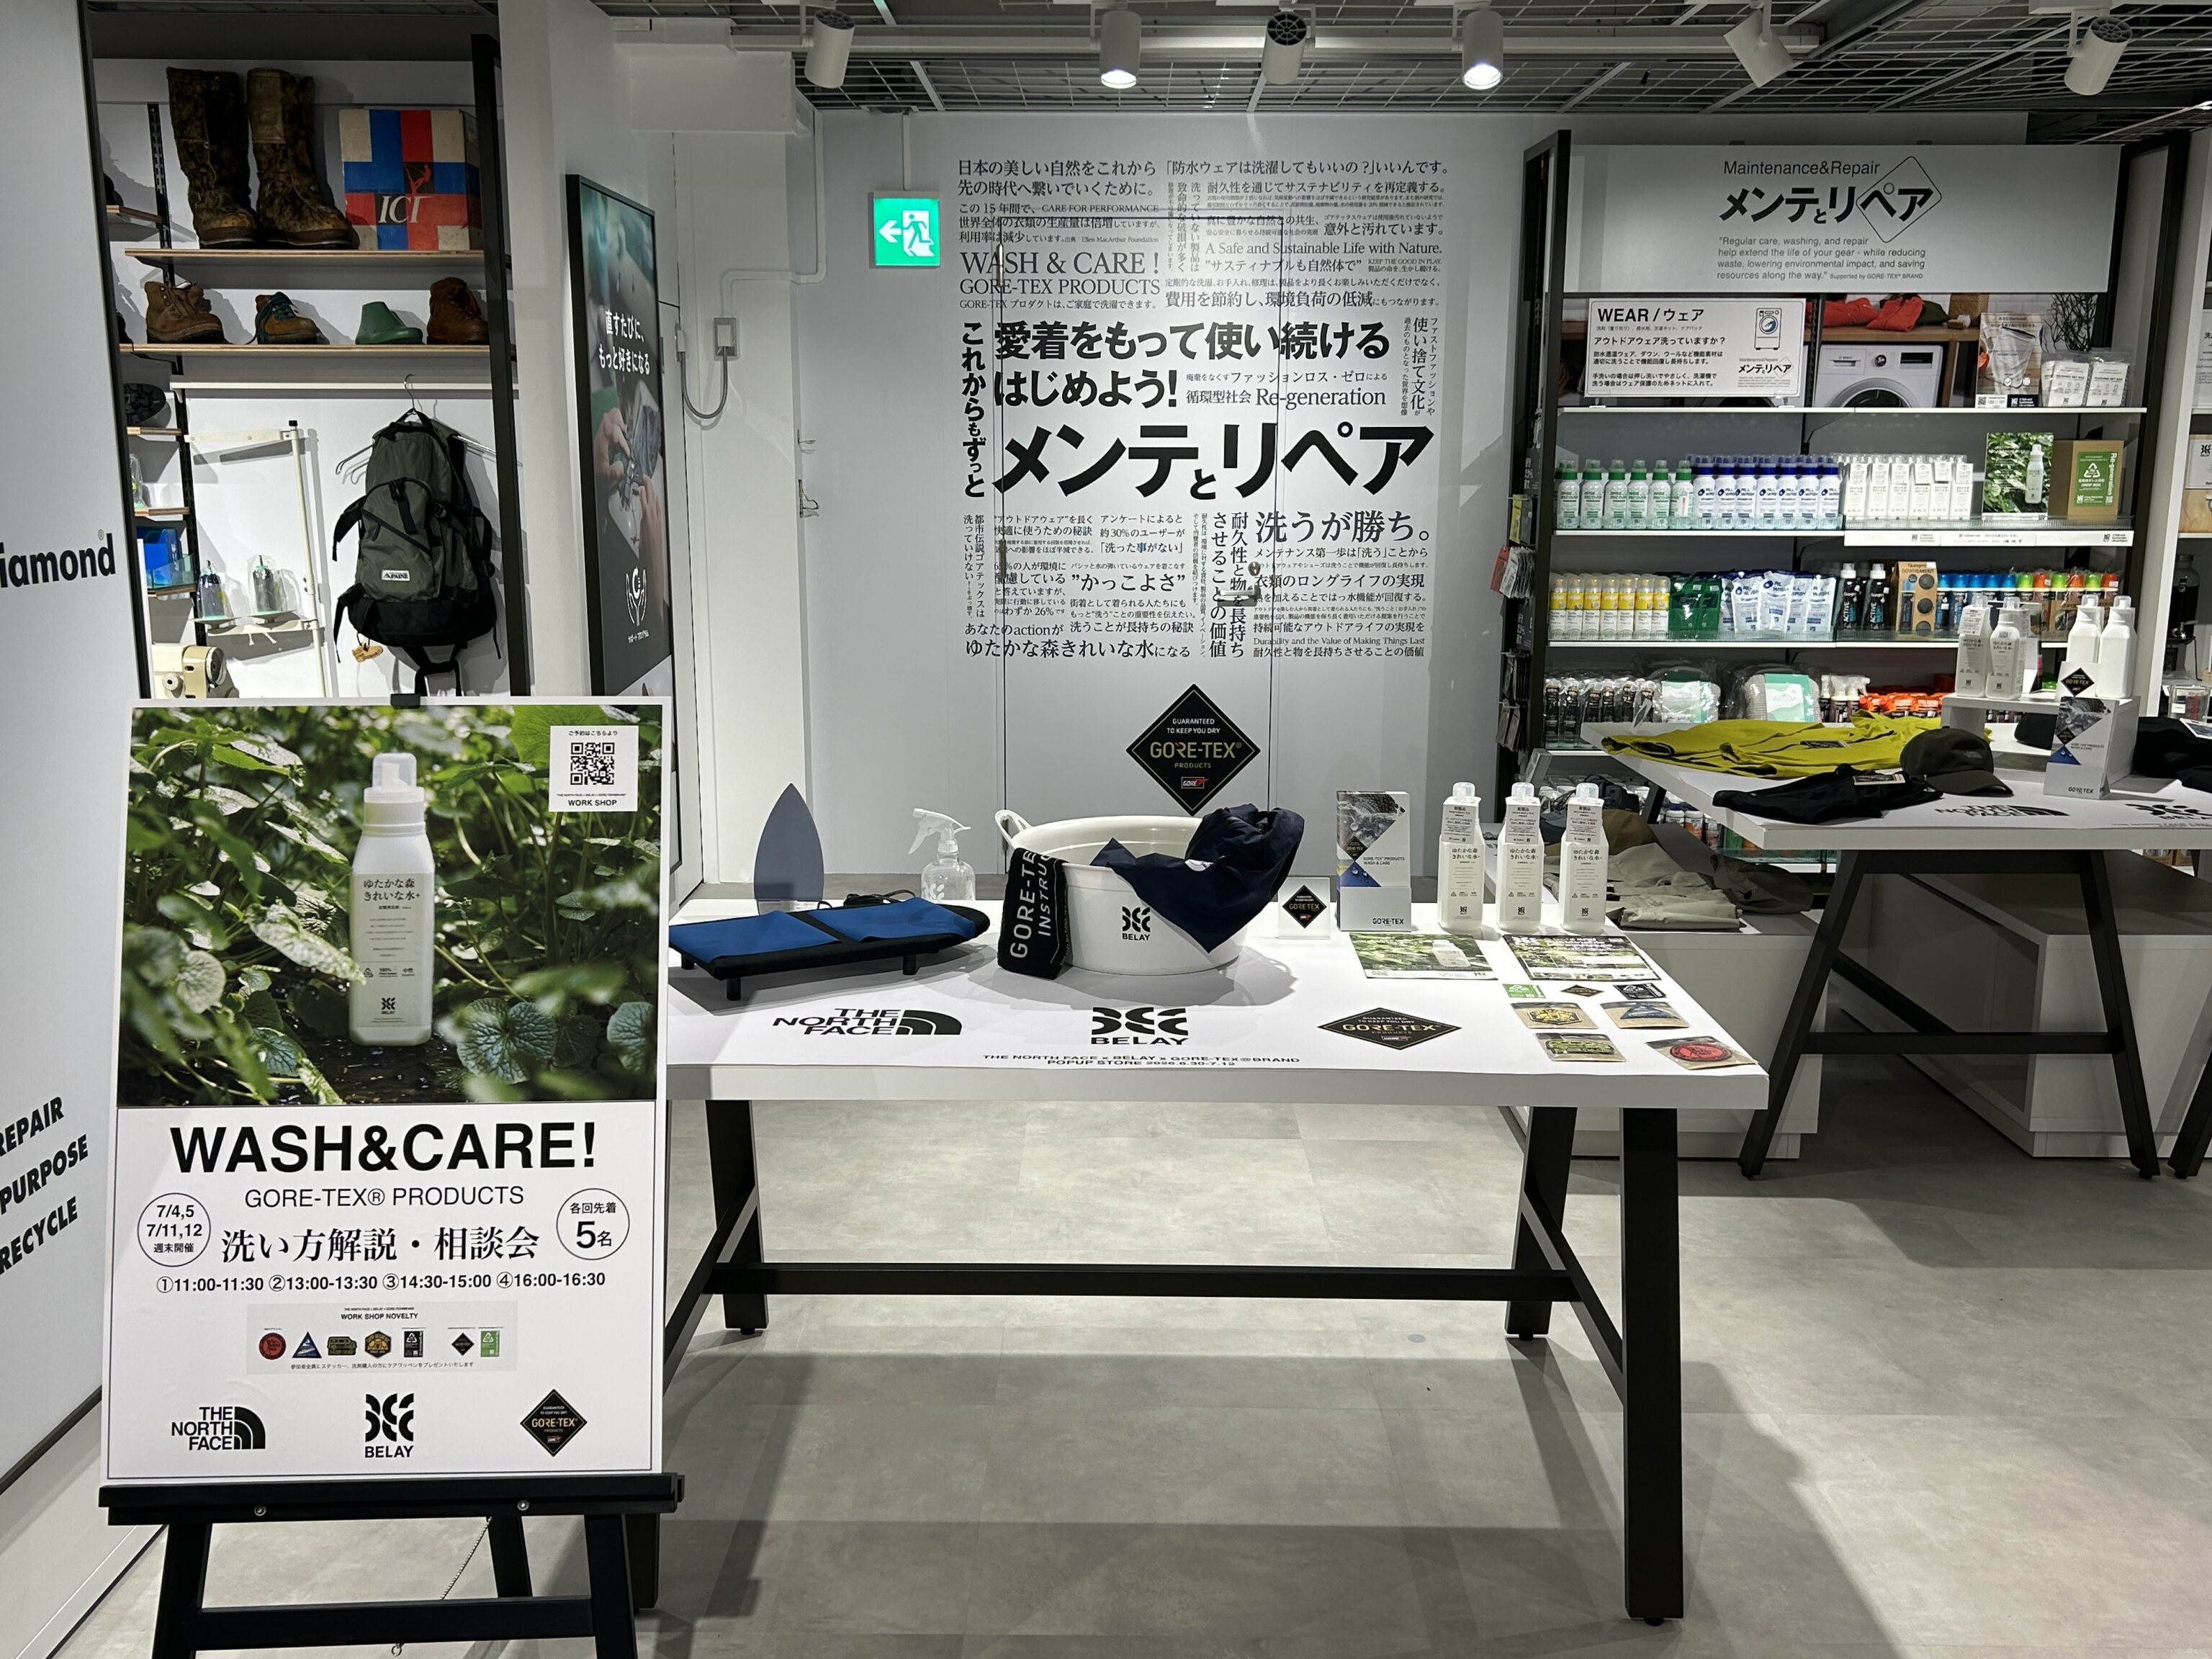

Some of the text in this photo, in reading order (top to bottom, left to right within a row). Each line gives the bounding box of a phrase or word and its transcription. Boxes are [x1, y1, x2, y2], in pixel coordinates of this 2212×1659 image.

[958, 159, 1156, 176] 日本の美しい自然をこれから
[1724, 161, 1880, 177] Maintenance&Repair
[958, 179, 1154, 197] 先の時代へ繋いでいくために。
[1208, 181, 1444, 194] 耐久性を通じてサステナビリティを再定義する。
[1719, 182, 1934, 224] メンテとリペア
[1324, 222, 1443, 235] 意外と汚れています。
[1205, 242, 1442, 254] A Safe and Sustainable Life with Nature.
[1718, 248, 1925, 257] help extend the life of your gear while reducing
[959, 252, 1038, 274] WASH
[1046, 251, 1066, 274] &
[1074, 252, 1146, 274] CARE
[1747, 260, 1783, 269] lowering
[1785, 260, 1844, 269] environmental
[1879, 260, 1895, 269] and
[1897, 260, 1925, 269] saving
[1717, 271, 1759, 279] resources
[1762, 271, 1785, 279] along
[1789, 271, 1802, 279] the
[960, 279, 1160, 295] GORE-TEX PRODUCTS
[959, 300, 1007, 309] GORE-TEX
[1165, 291, 1439, 307] 費用を節約し、環境負荷の低減にもつながります。
[1597, 308, 1704, 322] WEAR ウェア
[994, 320, 1390, 360] 愛着をもって使い続ける
[599, 343, 650, 375] もっと好きになる
[1187, 387, 1386, 410] 循環型社会 Re-generation
[961, 323, 986, 498] これからもずっと
[992, 421, 1434, 500] メンテとリペア
[1100, 515, 1183, 523] アンケートによると
[1255, 511, 1429, 543] 洗うが勝ち。
[1101, 541, 1183, 554] 「洗った事がない」
[1255, 547, 1428, 558] メンテナンス第一歩は「洗う」ことから
[975, 515, 985, 617] 都市伝説ゴアテックスは
[1070, 599, 1186, 608] 街着として着られる人たちにも
[1070, 621, 1194, 633] 洗うことが長持ちの秘訣
[1383, 637, 1408, 646] Things
[966, 639, 1190, 659] ゆたかな森きれいな水になる
[1253, 647, 1425, 658] 耐久性と物を長持ちさせることの価値
[363, 878, 415, 889] ゆたかな森
[835, 1008, 901, 1017] THE
[773, 1017, 899, 1026] NORTH
[804, 1026, 893, 1035] FACE
[170, 1121, 596, 1174] WASH&CARE!
[246, 1186, 524, 1208] GORE-TEX® PRODUCTS
[156, 1204, 195, 1220] 7/4,5
[570, 1202, 617, 1214] 各回先着
[146, 1223, 202, 1239] 7/11,12
[153, 1243, 194, 1253] 週末開催
[221, 1226, 540, 1263] 洗い方解説・相談会
[199, 1406, 233, 1421] THE
[171, 1421, 232, 1437] NORTH
[189, 1436, 233, 1450] FACE
[364, 1446, 414, 1459] BELAY
